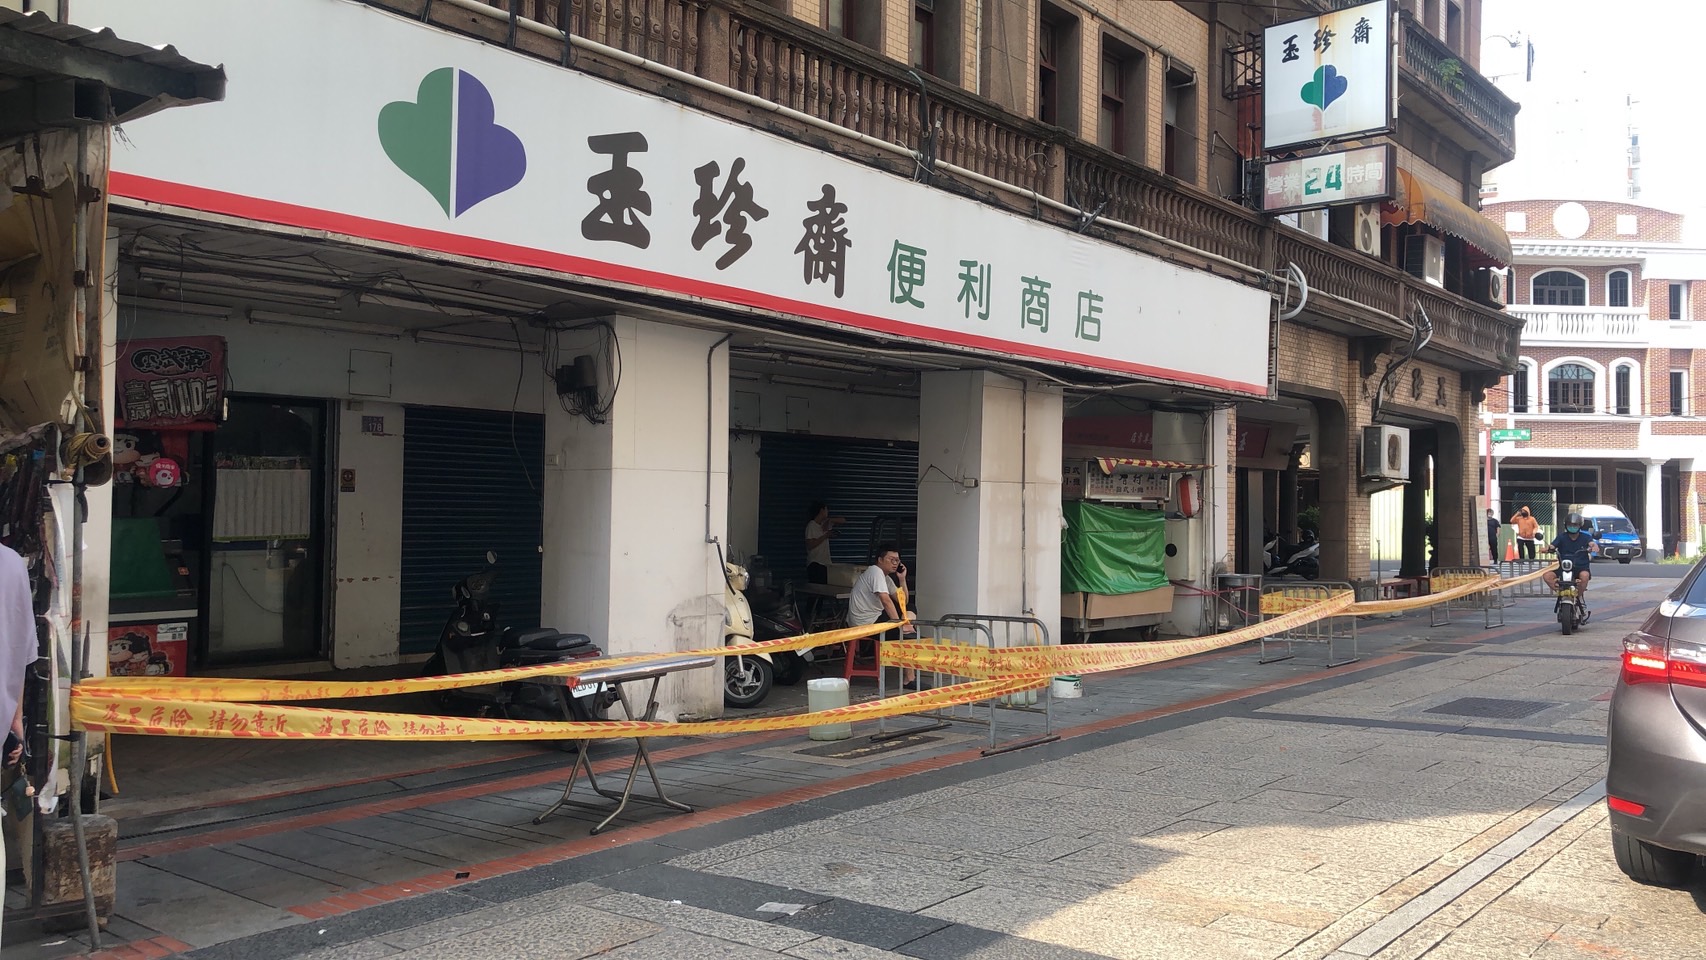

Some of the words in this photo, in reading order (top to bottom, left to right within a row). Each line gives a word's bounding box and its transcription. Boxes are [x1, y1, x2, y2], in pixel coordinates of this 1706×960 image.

[1281, 16, 1373, 64] 玉珍齋
[580, 130, 854, 299] 玉珍齋
[886, 238, 1105, 342] 便利商店
[368, 422, 382, 432] 178
[103, 703, 194, 728] 施工危險
[208, 709, 288, 733] 請勿靠近
